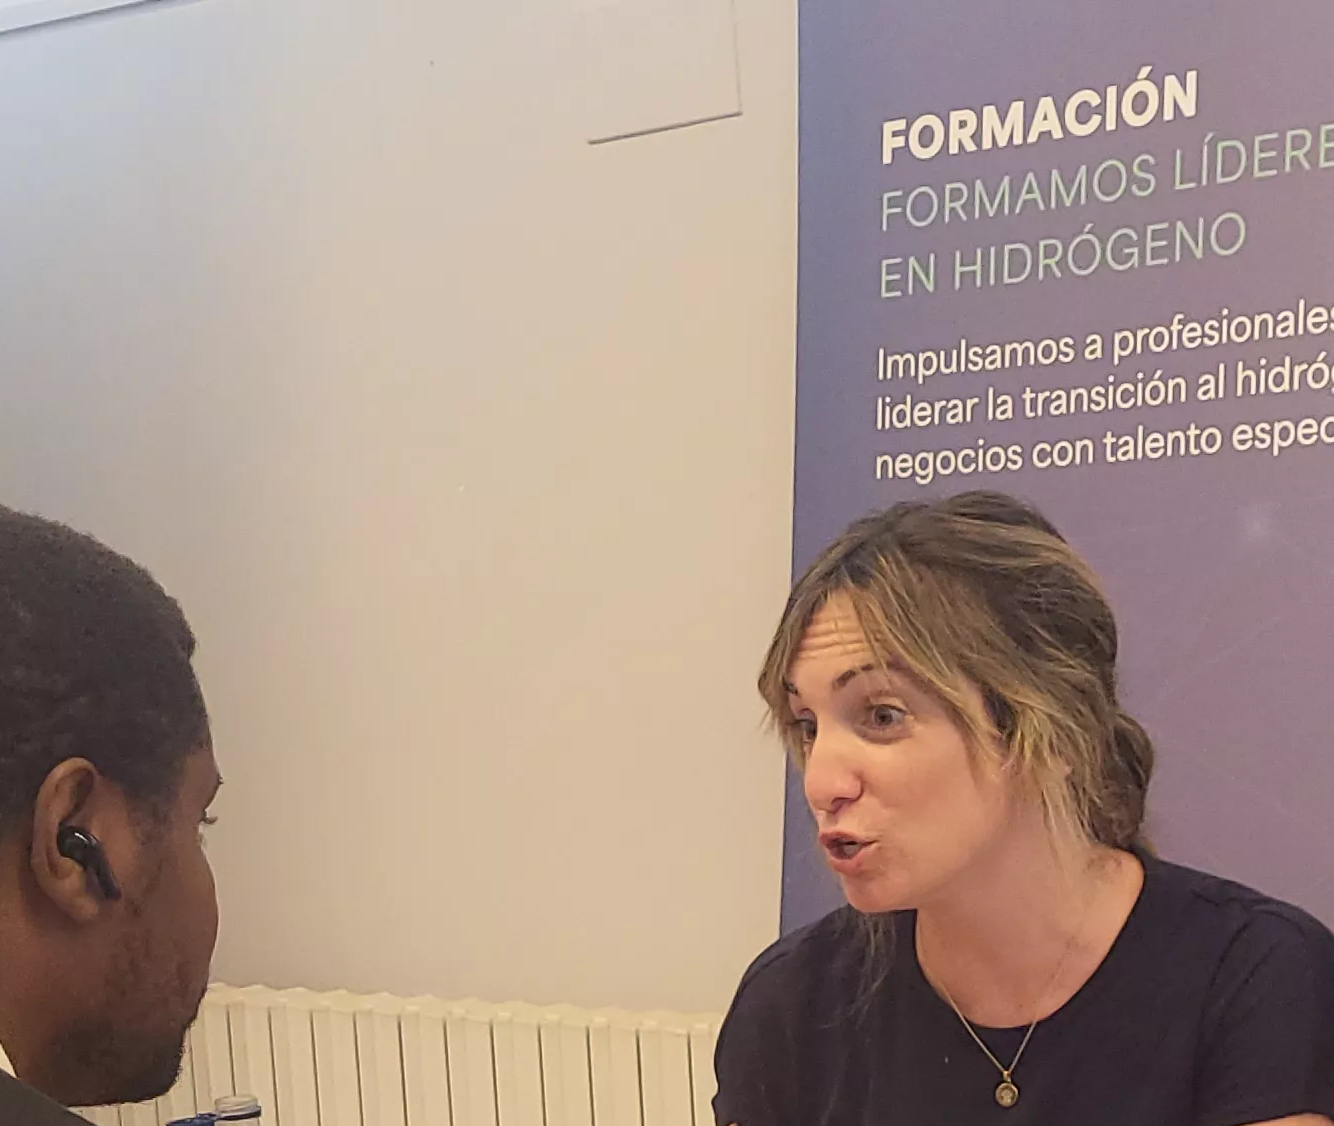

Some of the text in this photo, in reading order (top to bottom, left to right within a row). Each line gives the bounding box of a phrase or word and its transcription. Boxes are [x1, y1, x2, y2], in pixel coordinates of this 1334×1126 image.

[881, 66, 1199, 164] FORMACIÓN
[881, 153, 1156, 231] FORMAMOS
[880, 211, 1246, 298] EN HIDRÓGENO
[877, 339, 1075, 385] Impulsamos
[1083, 334, 1103, 360] a
[875, 395, 980, 431] liderar
[987, 387, 1013, 421] la
[1021, 369, 1186, 418] transición
[1197, 362, 1225, 401] al
[875, 439, 1023, 485] negocios
[1031, 438, 1094, 470] con
[1102, 422, 1222, 464] talento
